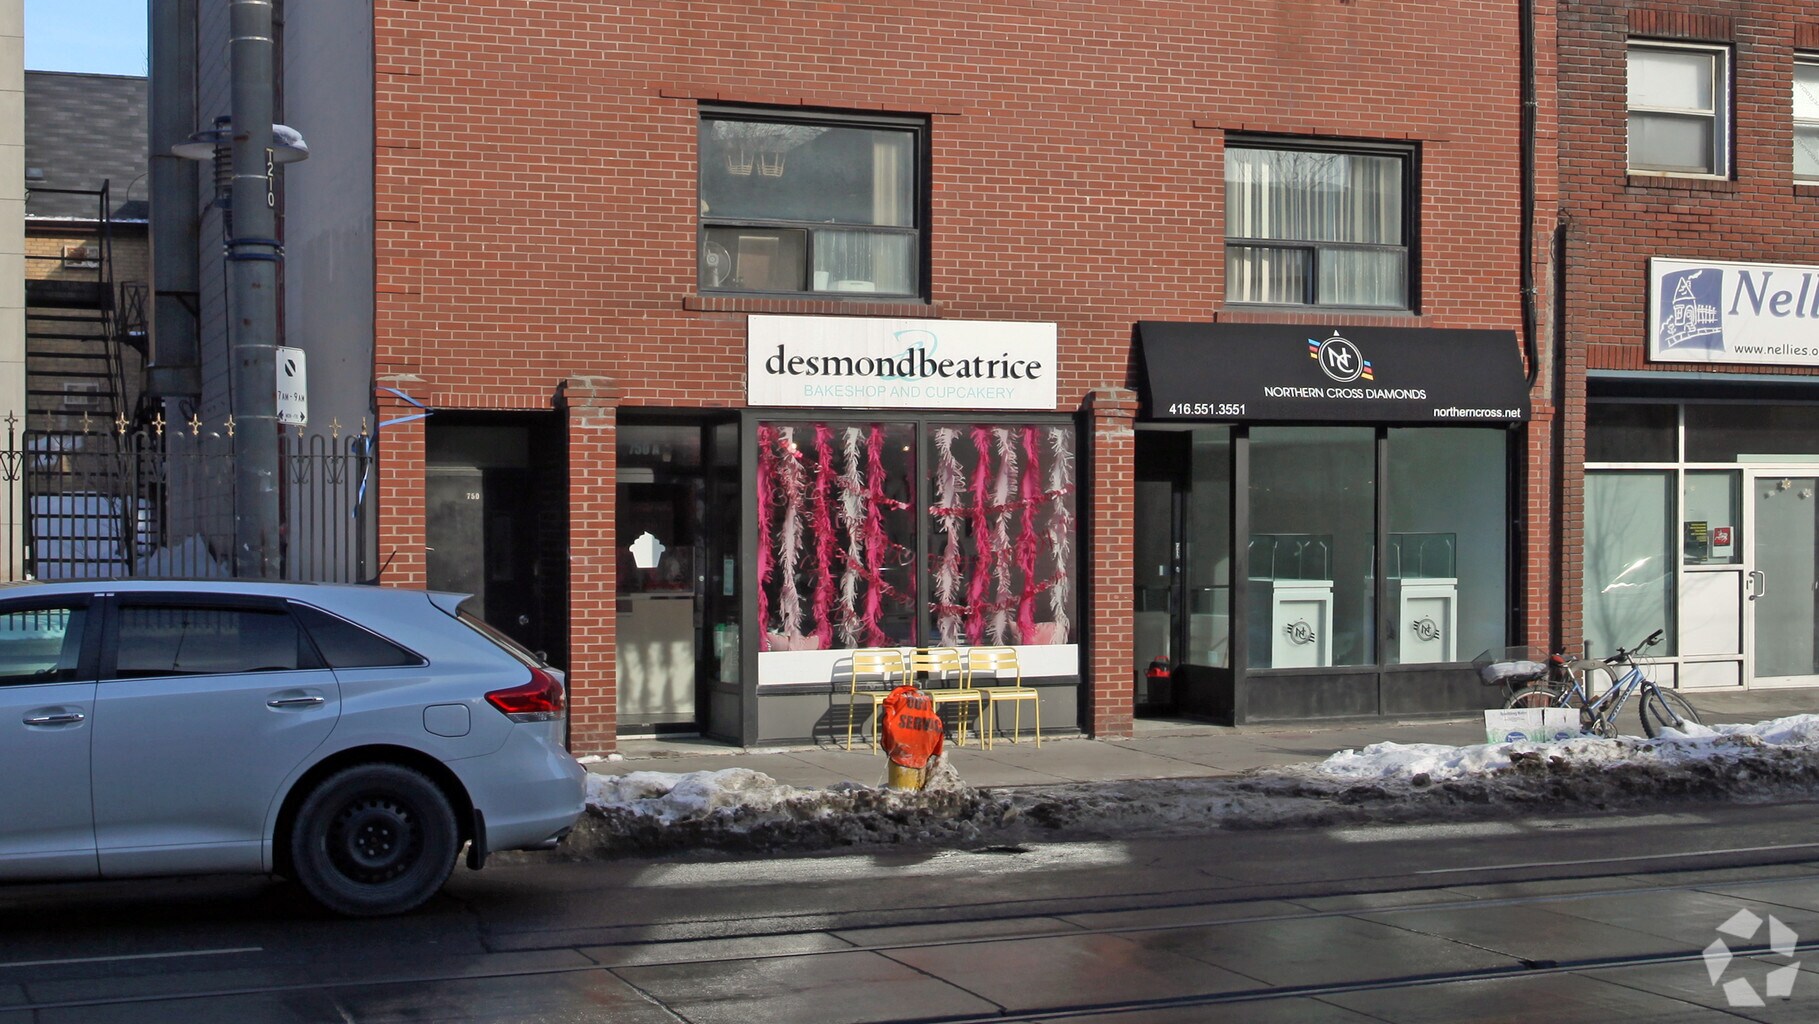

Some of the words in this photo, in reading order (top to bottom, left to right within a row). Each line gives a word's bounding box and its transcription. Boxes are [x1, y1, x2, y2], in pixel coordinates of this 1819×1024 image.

[266, 147, 275, 207] T210
[765, 344, 1042, 380] desmondbeatrice
[804, 384, 887, 397] BAKESHOP
[890, 385, 921, 398] AND
[925, 386, 1015, 399] CUPCAKERY
[1264, 386, 1324, 399] NORTHERN
[1326, 387, 1364, 400] CROSS
[1366, 388, 1427, 401] DIAMONDS
[1169, 403, 1246, 415] 416.551.3551
[1433, 406, 1521, 418] northerncross.net
